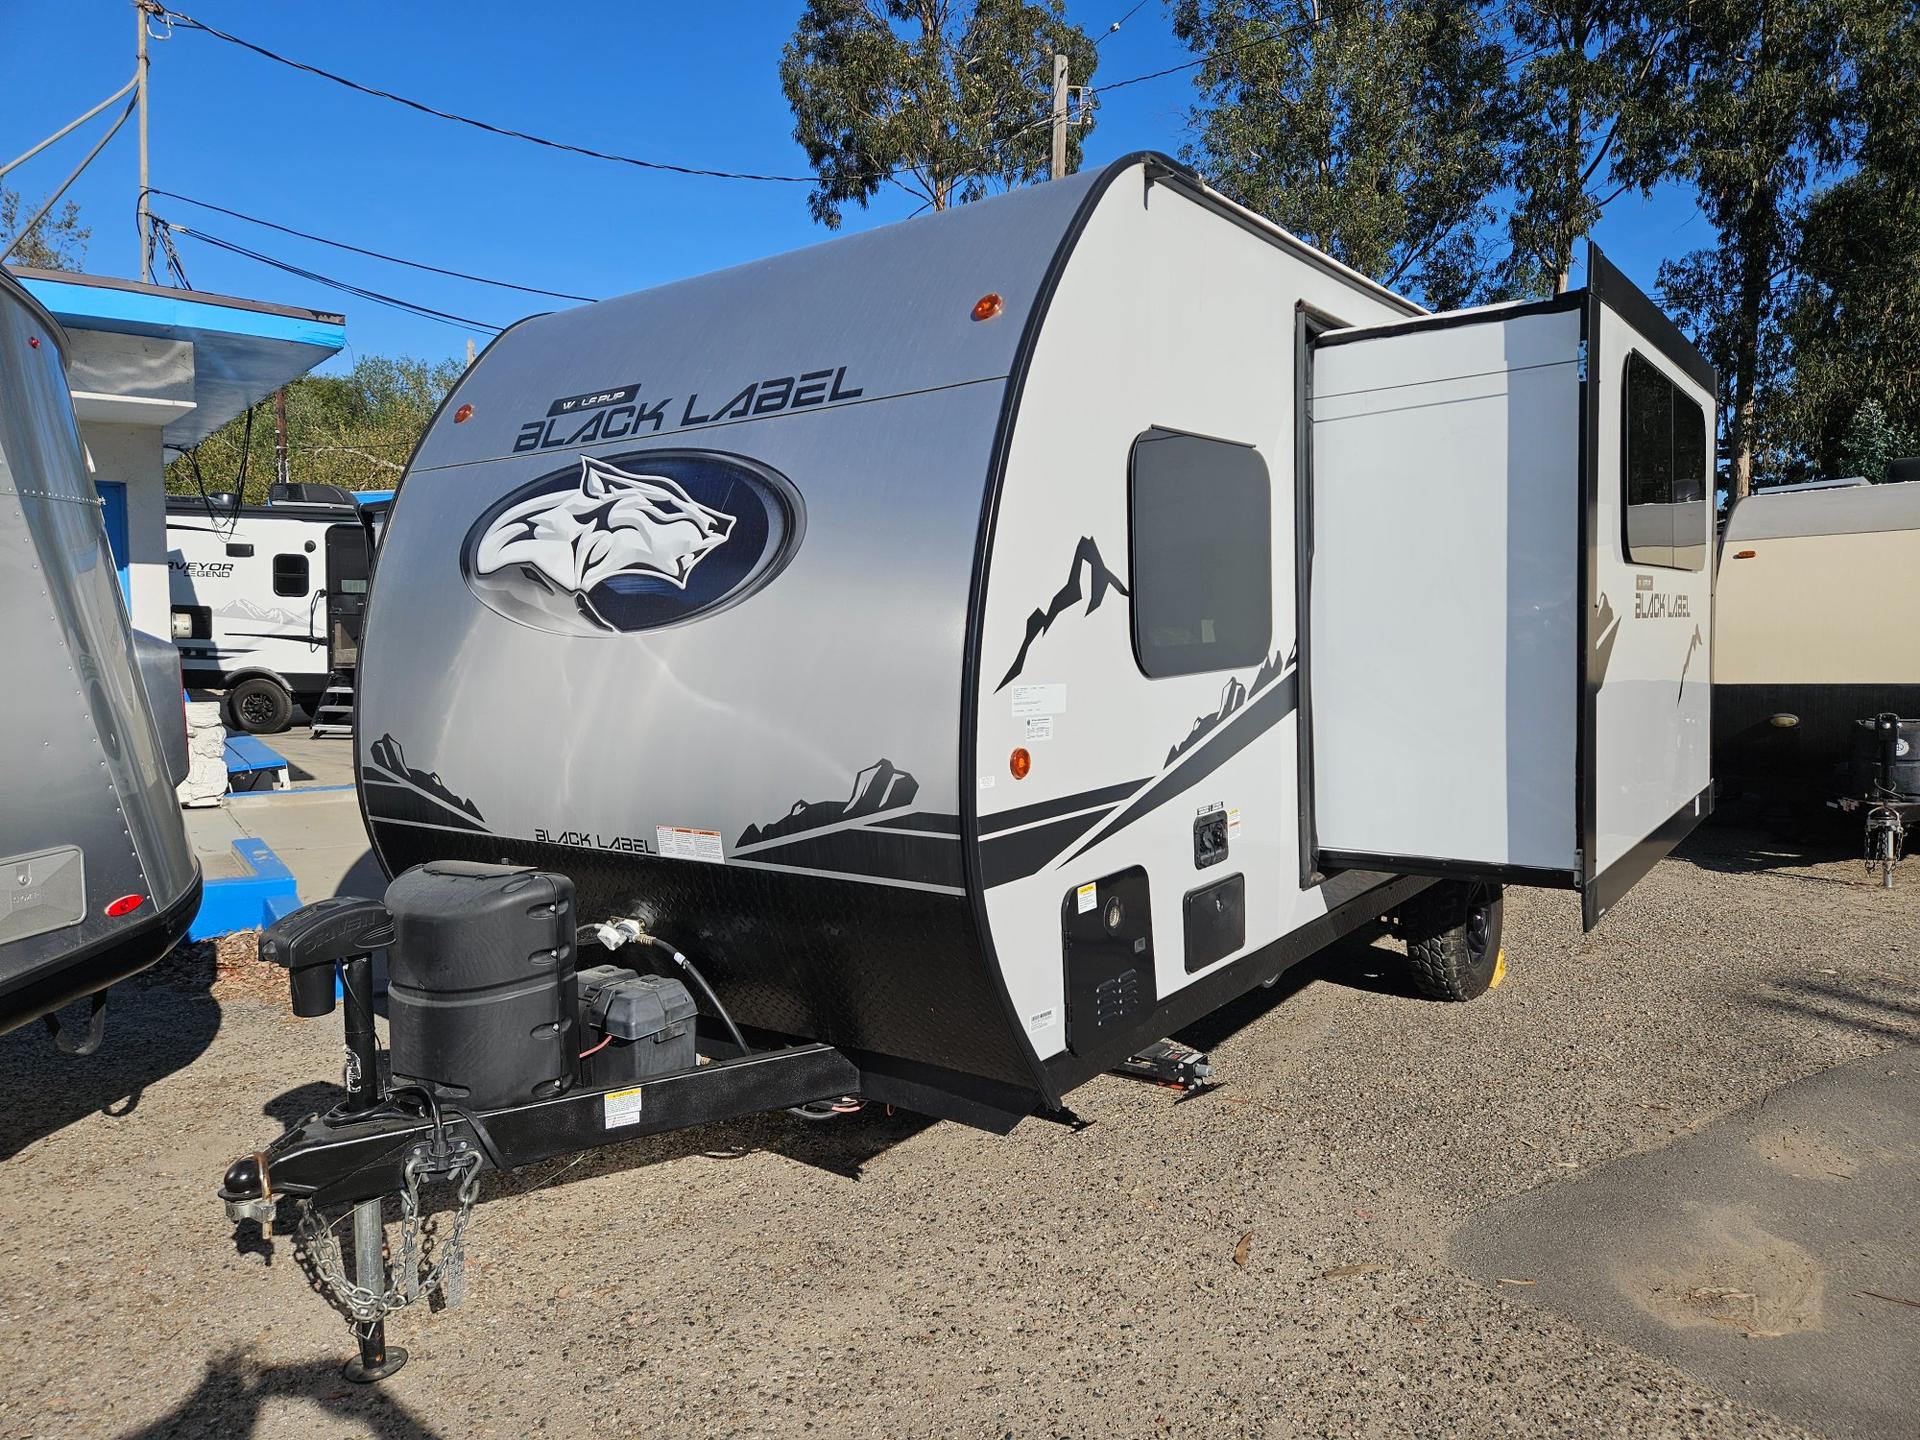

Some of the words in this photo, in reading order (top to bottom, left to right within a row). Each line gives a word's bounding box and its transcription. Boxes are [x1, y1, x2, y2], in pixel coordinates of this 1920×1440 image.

[513, 398, 673, 453] BLACK
[680, 366, 864, 427] LABEL
[563, 396, 597, 410] WLF
[1635, 592, 1665, 618] BLACK
[1667, 594, 1691, 618] LABEL
[535, 829, 592, 847] BLACK
[596, 835, 657, 854] LABEL
